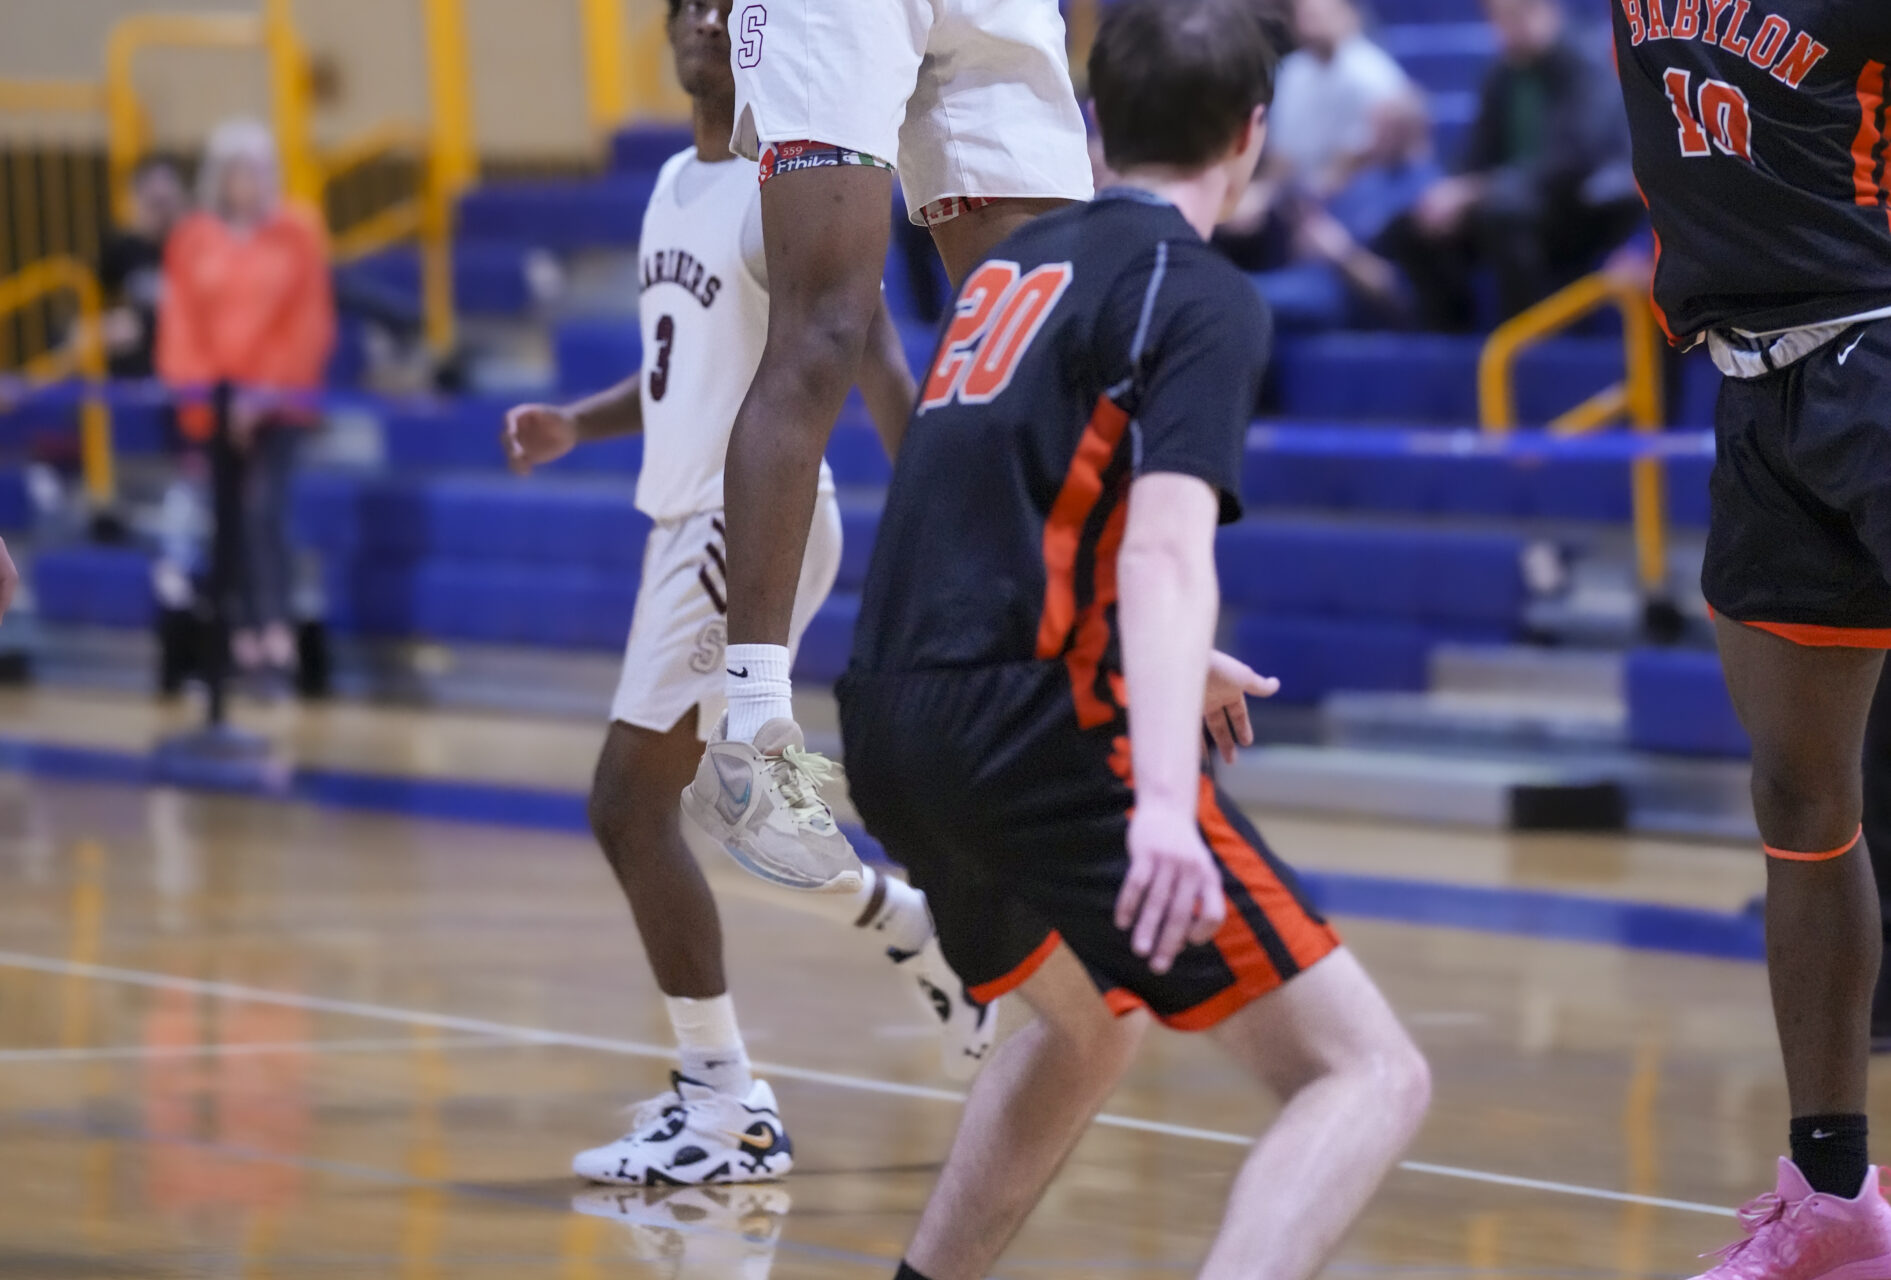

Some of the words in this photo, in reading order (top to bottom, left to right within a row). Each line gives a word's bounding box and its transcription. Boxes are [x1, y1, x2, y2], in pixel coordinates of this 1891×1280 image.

[738, 4, 767, 69] S
[783, 146, 803, 156] 559
[1663, 67, 1753, 163] 10
[649, 314, 674, 401] 3
[916, 259, 1073, 417] 20
